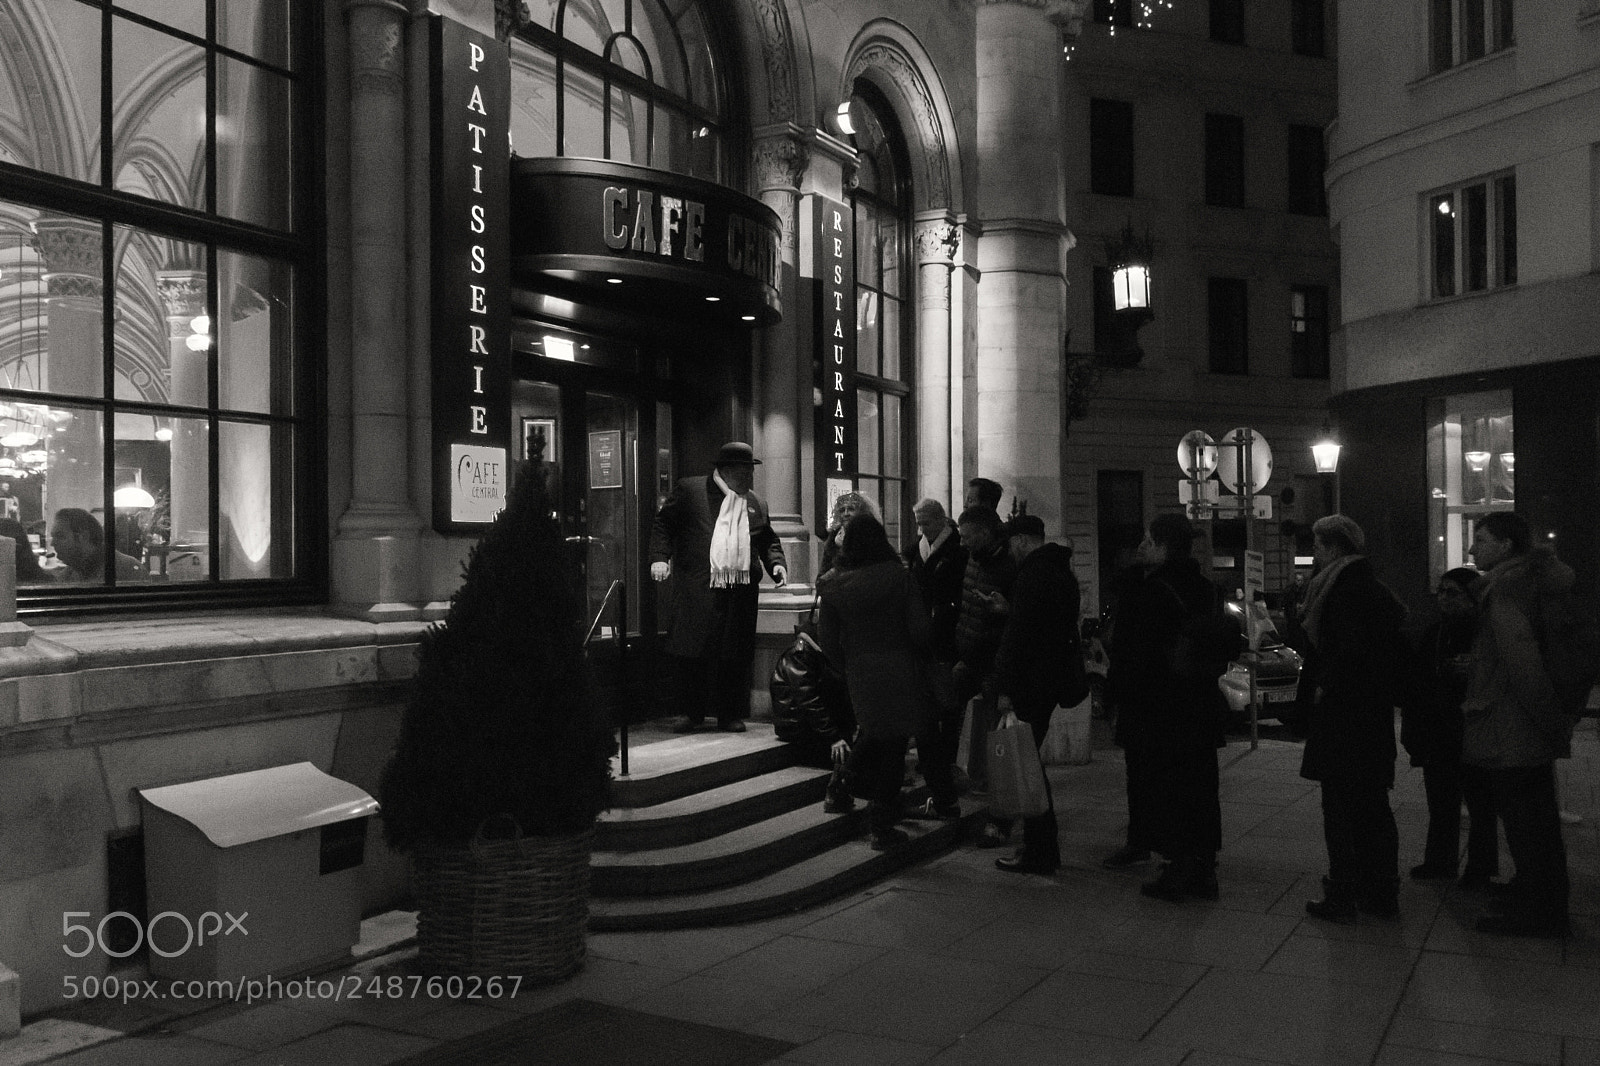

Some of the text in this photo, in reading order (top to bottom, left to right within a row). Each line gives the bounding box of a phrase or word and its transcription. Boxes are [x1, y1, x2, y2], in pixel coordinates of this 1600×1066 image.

[468, 42, 489, 436] PATISSERIE
[603, 186, 705, 262] CAFE
[832, 210, 845, 472] RESTAURANT
